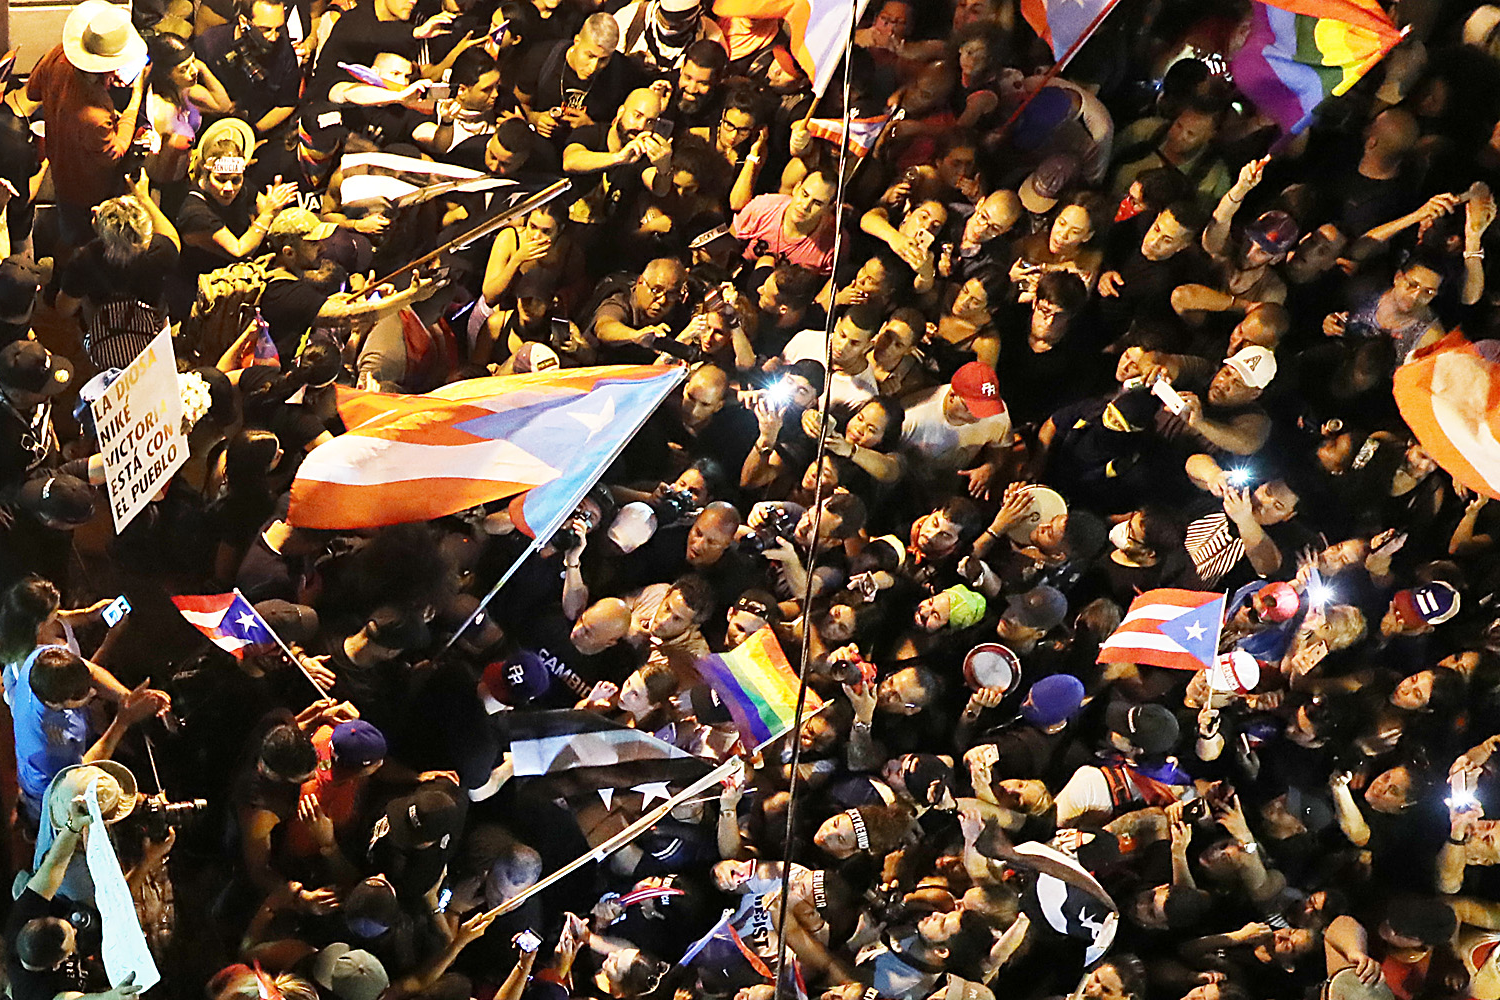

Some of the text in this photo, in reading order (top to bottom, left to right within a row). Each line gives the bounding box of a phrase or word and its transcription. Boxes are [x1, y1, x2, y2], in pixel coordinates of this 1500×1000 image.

[93, 347, 157, 423] LA DIOSA
[99, 395, 132, 447] NIKÉ
[105, 398, 168, 468] VICTORIA
[112, 422, 174, 497] ESTÁ CON
[115, 443, 178, 521] EL PUEBLO
